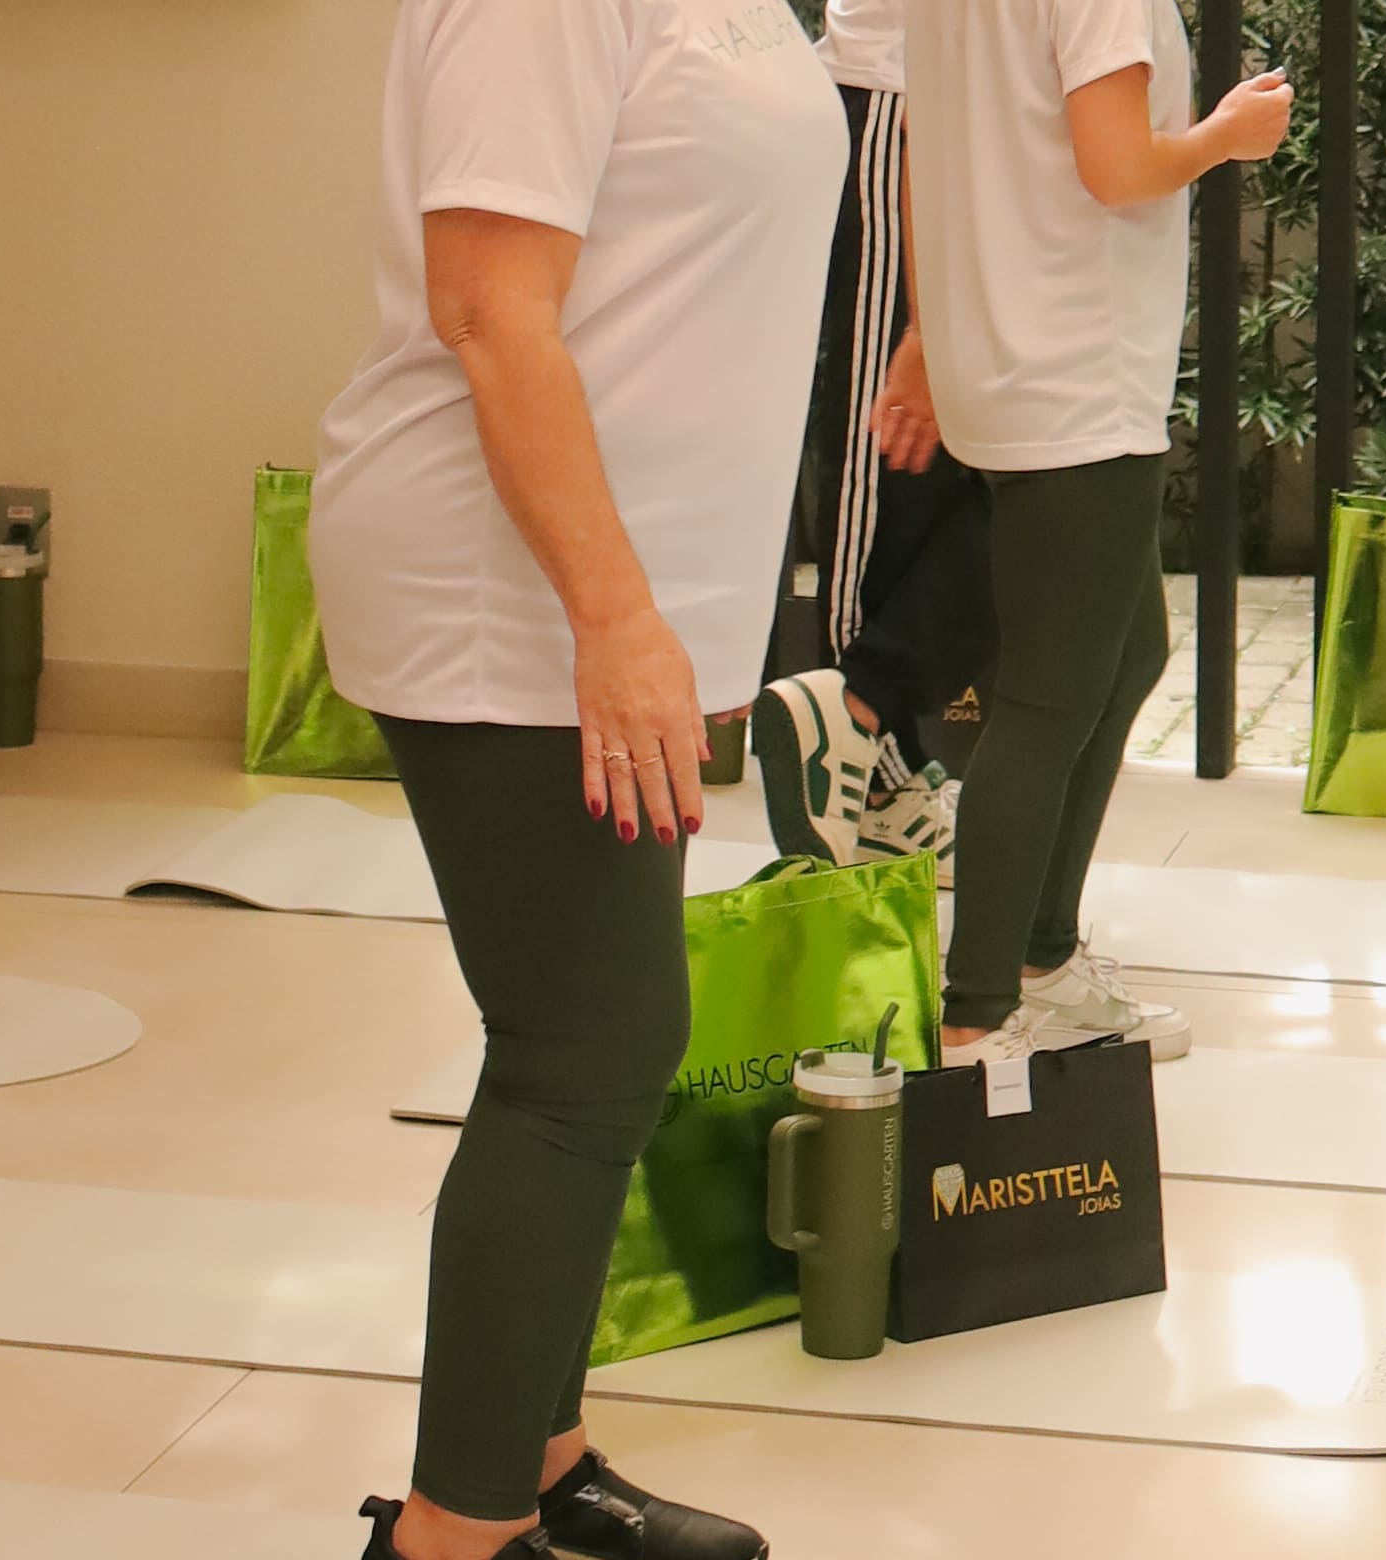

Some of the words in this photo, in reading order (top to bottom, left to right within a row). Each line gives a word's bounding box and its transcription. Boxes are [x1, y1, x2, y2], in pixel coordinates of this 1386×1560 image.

[883, 1117, 895, 1212] HAUSGARTEN
[933, 1159, 1119, 1222] MARISTTELA
[1077, 1193, 1122, 1216] JOIAS
